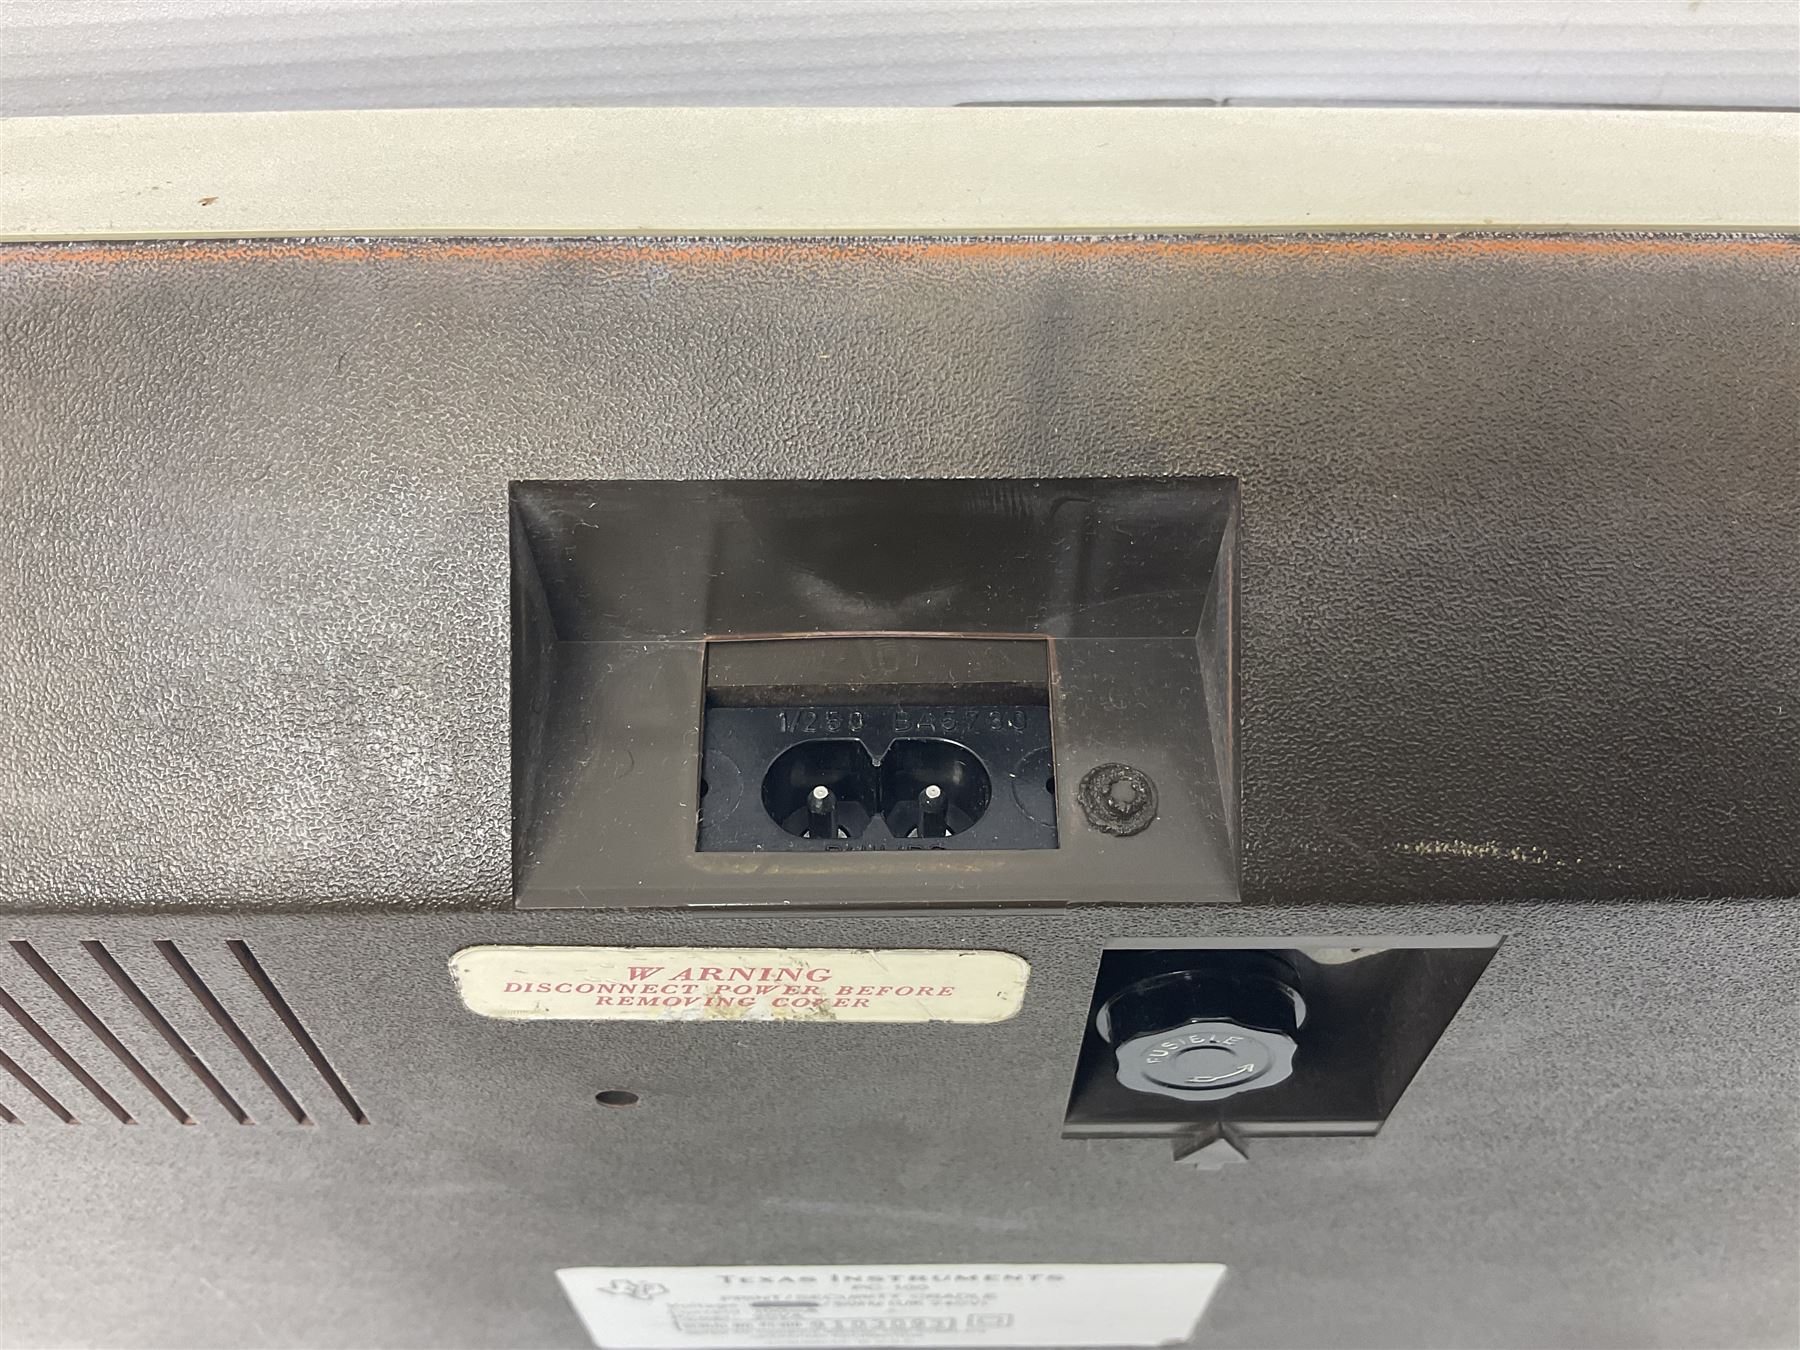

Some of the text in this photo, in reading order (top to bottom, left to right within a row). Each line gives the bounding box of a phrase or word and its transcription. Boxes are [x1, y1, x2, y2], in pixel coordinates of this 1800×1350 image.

[627, 966, 833, 982] WARNING
[503, 982, 955, 997] DISCONNECT POWER BEFORE
[596, 996, 870, 1008] REMOVING COVER
[717, 1273, 1066, 1285] TEXAS INSTRUMENTS
